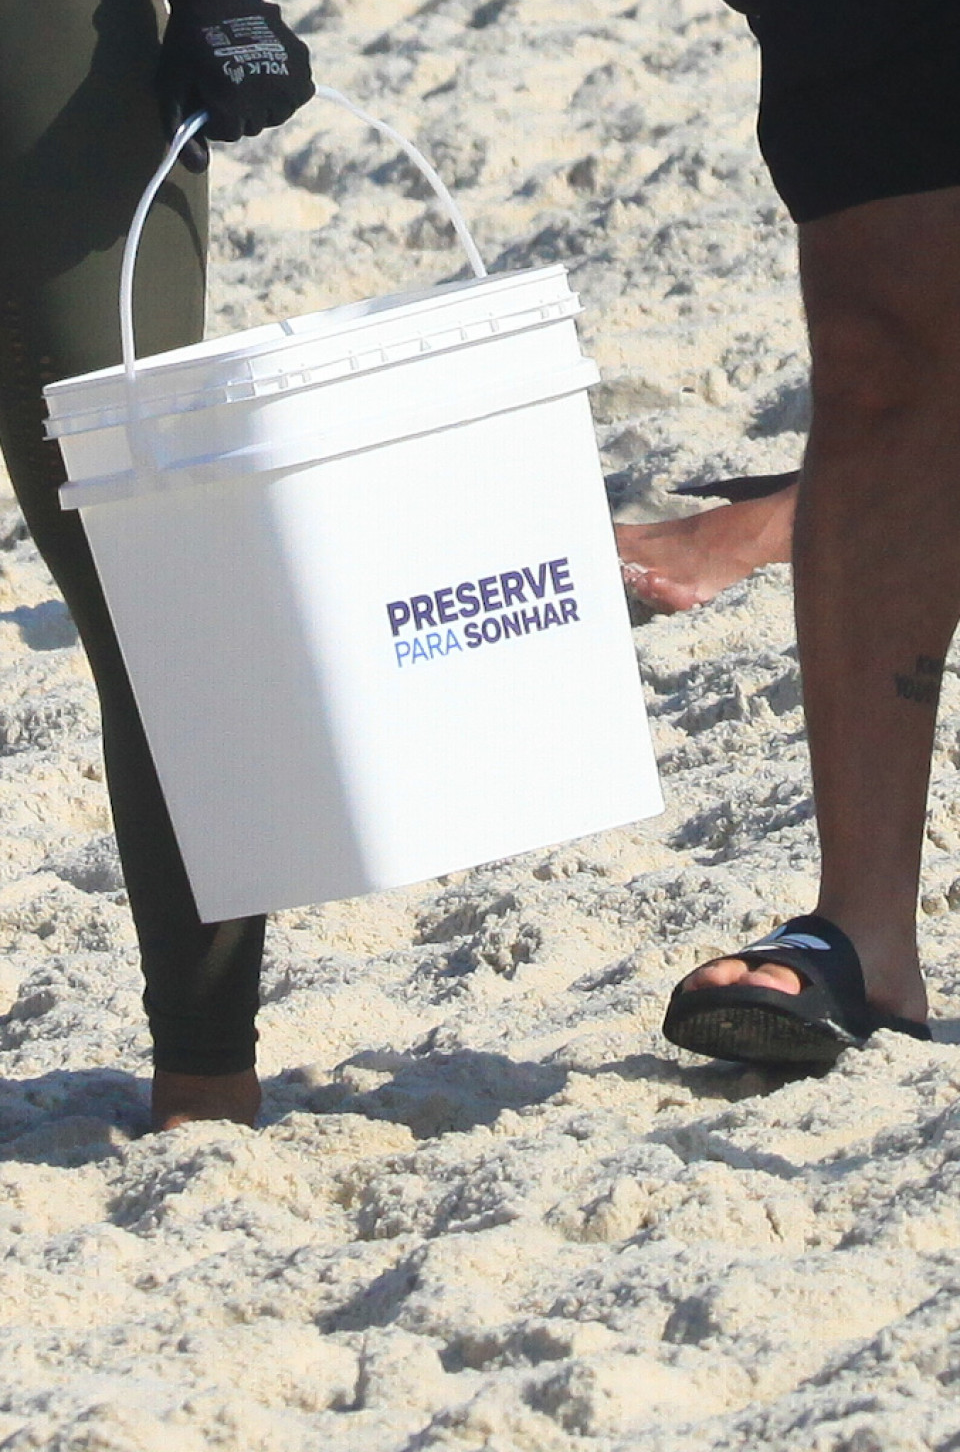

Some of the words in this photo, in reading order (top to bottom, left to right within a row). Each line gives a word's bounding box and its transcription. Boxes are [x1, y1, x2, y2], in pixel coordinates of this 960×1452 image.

[387, 557, 574, 637] PRESERVE
[395, 629, 463, 668] PARA
[464, 598, 580, 648] SONHAR
